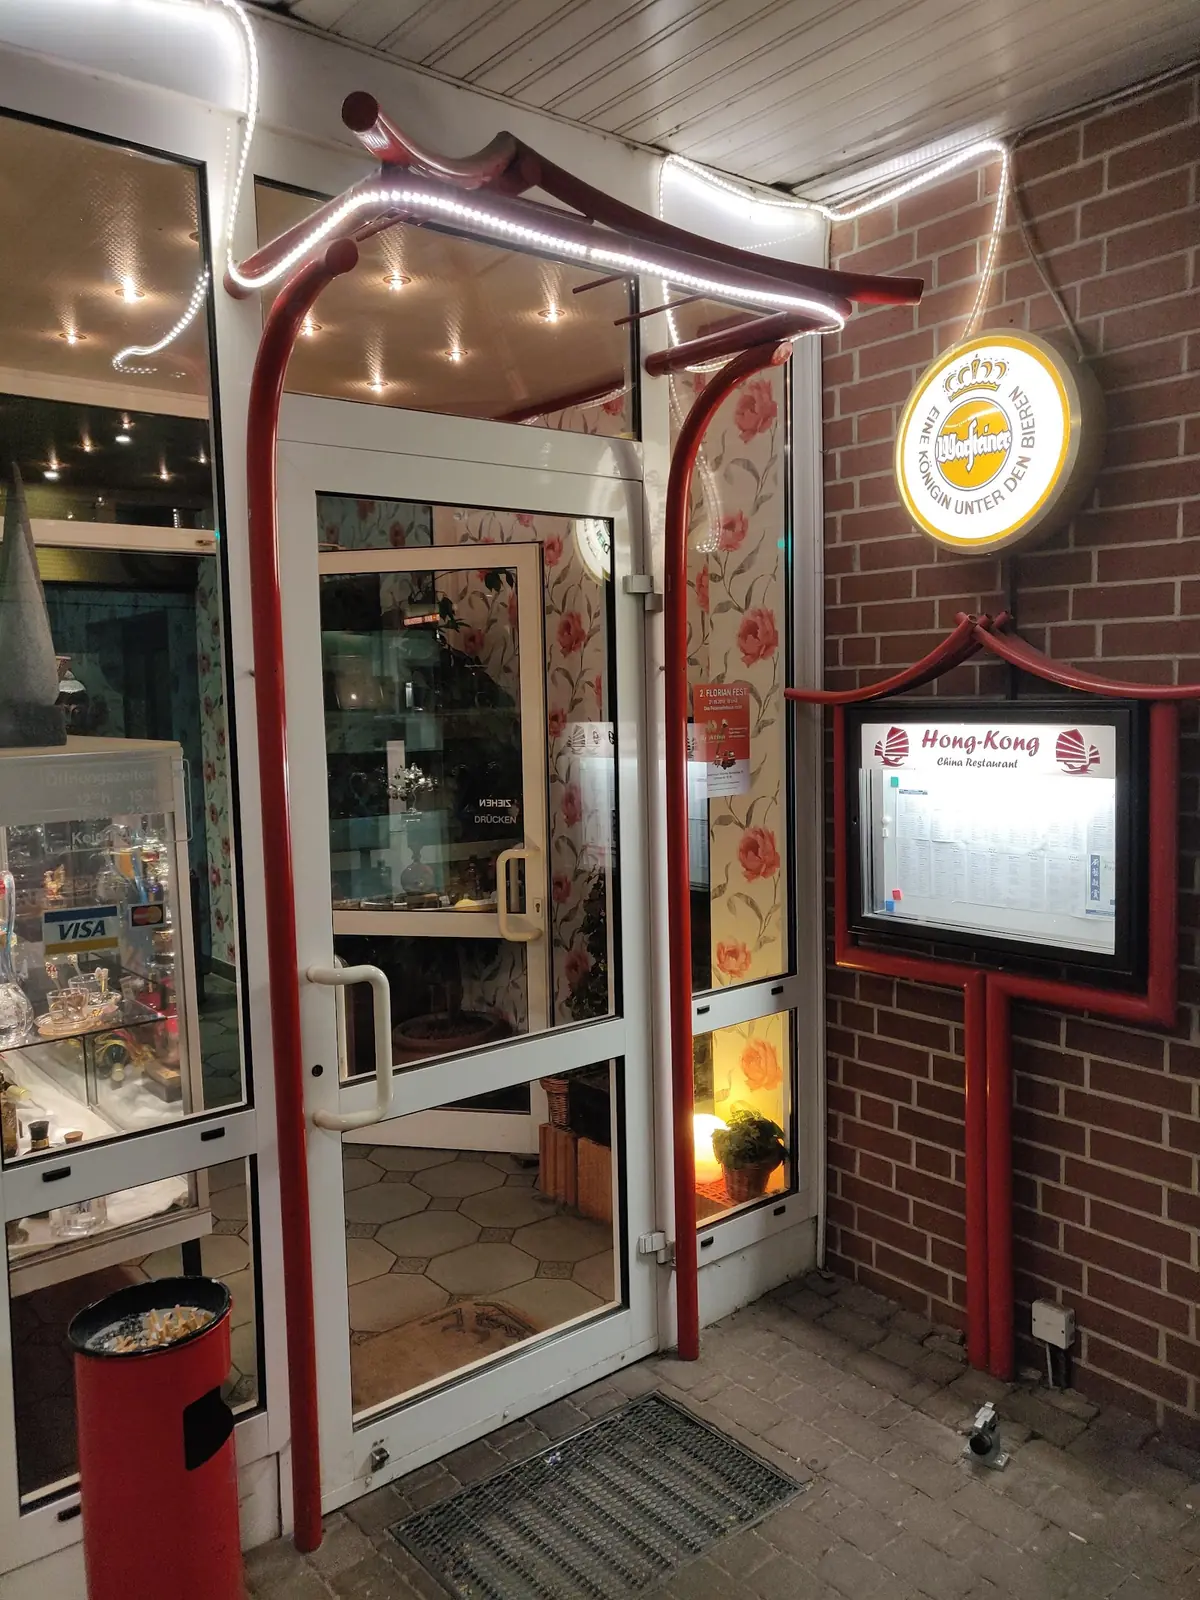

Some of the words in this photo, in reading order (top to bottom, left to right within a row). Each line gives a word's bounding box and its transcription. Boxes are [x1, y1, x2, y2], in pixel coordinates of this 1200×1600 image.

[918, 406, 940, 446] EINE
[1008, 385, 1036, 449] BIEREN
[918, 450, 952, 511] KÖNIGIN
[1003, 455, 1032, 493] DEN
[954, 489, 1006, 515] UNTER
[706, 688, 732, 698] FLORIAN
[732, 687, 747, 696] FEST
[921, 729, 1040, 757] Hong-Kong
[937, 757, 963, 767] China
[965, 757, 1018, 769] Restaurant
[474, 814, 516, 824] DRÜCKEN
[58, 920, 106, 940] VISA
